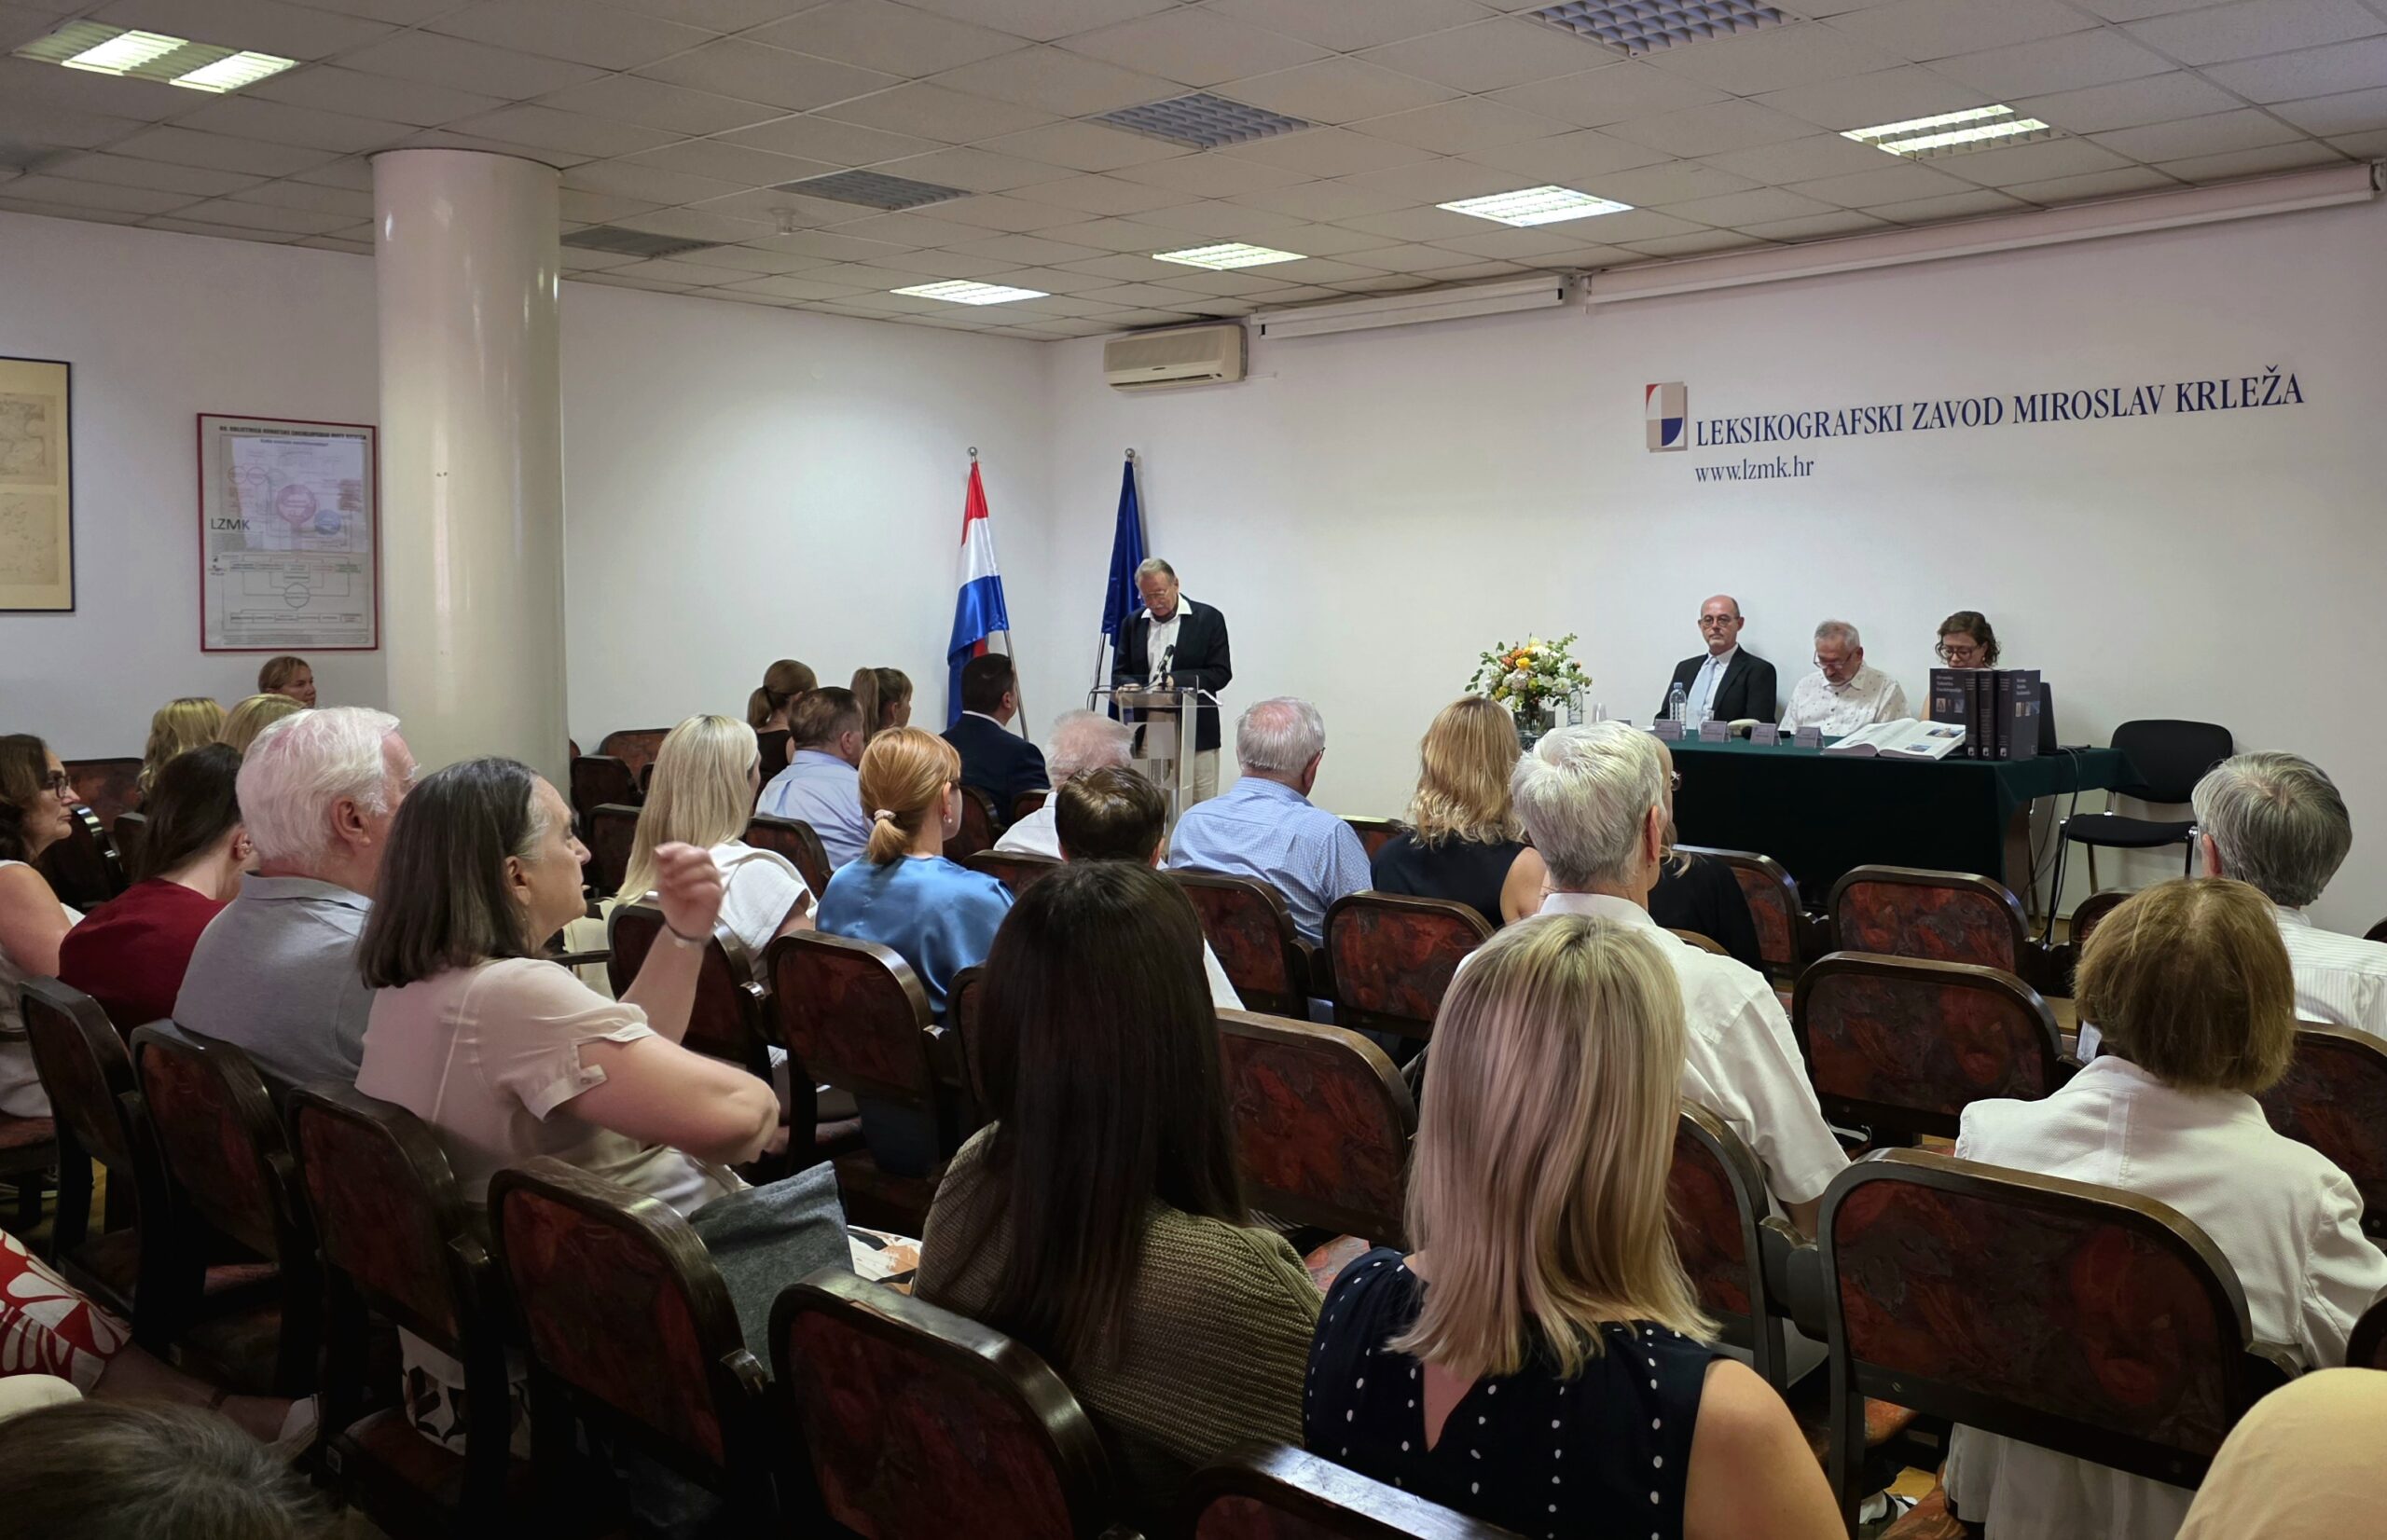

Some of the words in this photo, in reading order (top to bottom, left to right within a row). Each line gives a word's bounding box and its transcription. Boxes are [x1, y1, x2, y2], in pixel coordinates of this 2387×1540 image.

[1696, 404, 1903, 447] LEKSIKOGRAFSKI
[1911, 396, 2004, 431] ZAVOD
[2012, 384, 2166, 425] MIROSLAV
[2174, 364, 2305, 413] KRLEŽA
[1694, 454, 1814, 483] www.lzmk.hr
[211, 518, 250, 530] LZMK
